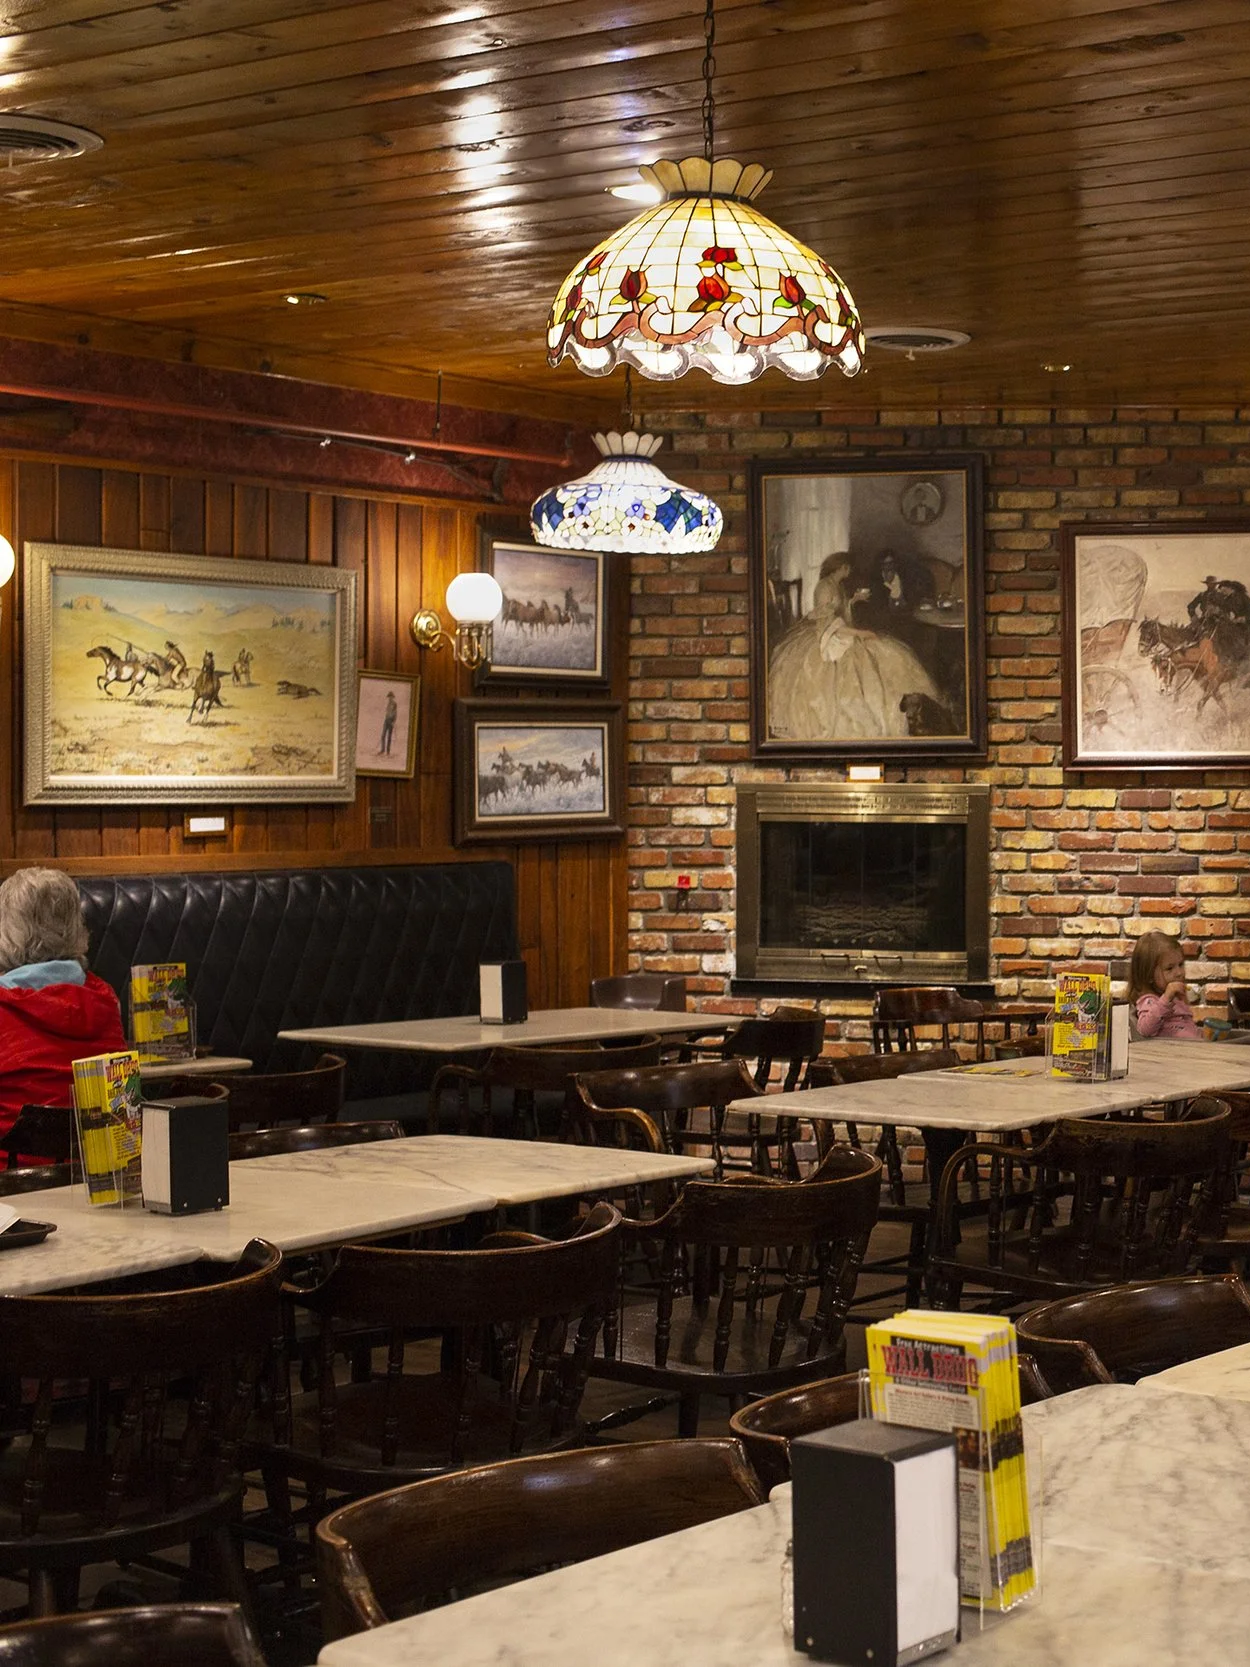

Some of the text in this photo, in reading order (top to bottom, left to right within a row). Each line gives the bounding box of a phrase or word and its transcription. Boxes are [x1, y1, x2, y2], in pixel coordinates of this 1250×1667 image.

[1059, 980, 1097, 992] WALL DRUG
[105, 1062, 122, 1082] WALL
[895, 1338, 960, 1355] Free Attractions
[881, 1345, 980, 1390] WALL DRUG
